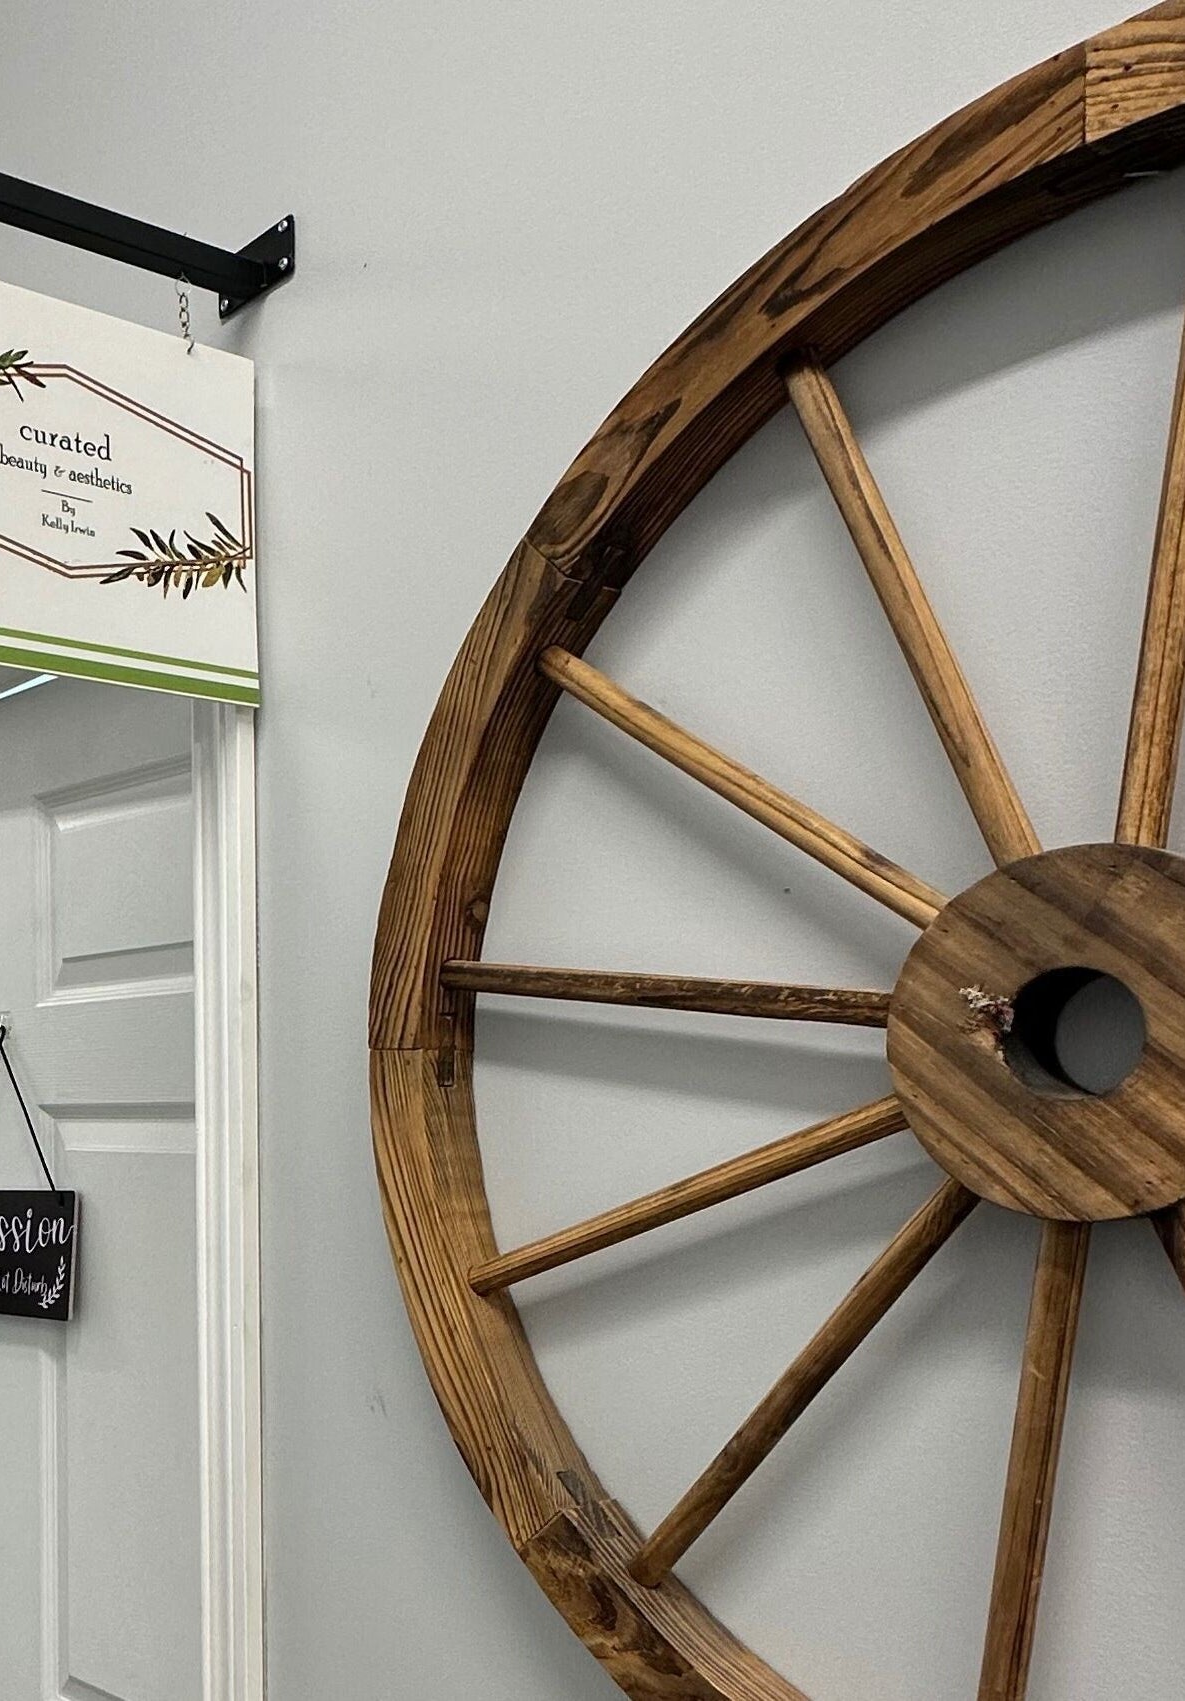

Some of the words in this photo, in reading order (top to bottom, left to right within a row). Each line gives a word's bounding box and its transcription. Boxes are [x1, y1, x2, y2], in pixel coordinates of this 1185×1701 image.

[19, 424, 112, 461] curated
[0, 442, 47, 479] beauty
[54, 465, 65, 478] &
[68, 467, 133, 495] aesthetics
[61, 500, 76, 517] By
[41, 513, 69, 534] Kelly
[71, 520, 96, 537] Irwin
[12, 1267, 49, 1296] Disturb
